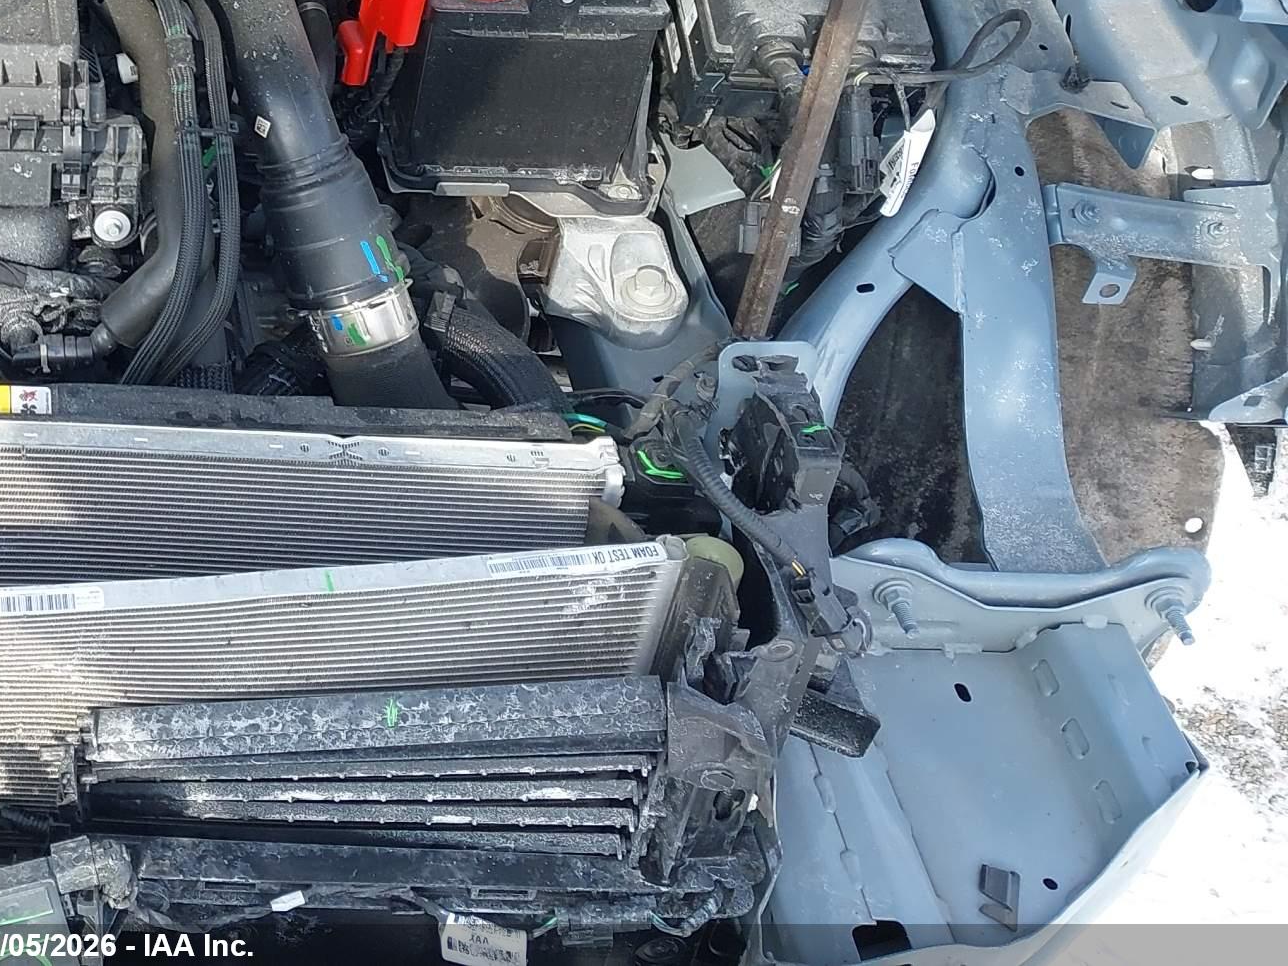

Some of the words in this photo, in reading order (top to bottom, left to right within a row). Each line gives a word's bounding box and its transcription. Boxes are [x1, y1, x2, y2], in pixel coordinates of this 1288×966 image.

[592, 551, 606, 564] OK
[609, 548, 632, 563] TEST
[630, 546, 659, 558] FOAM
